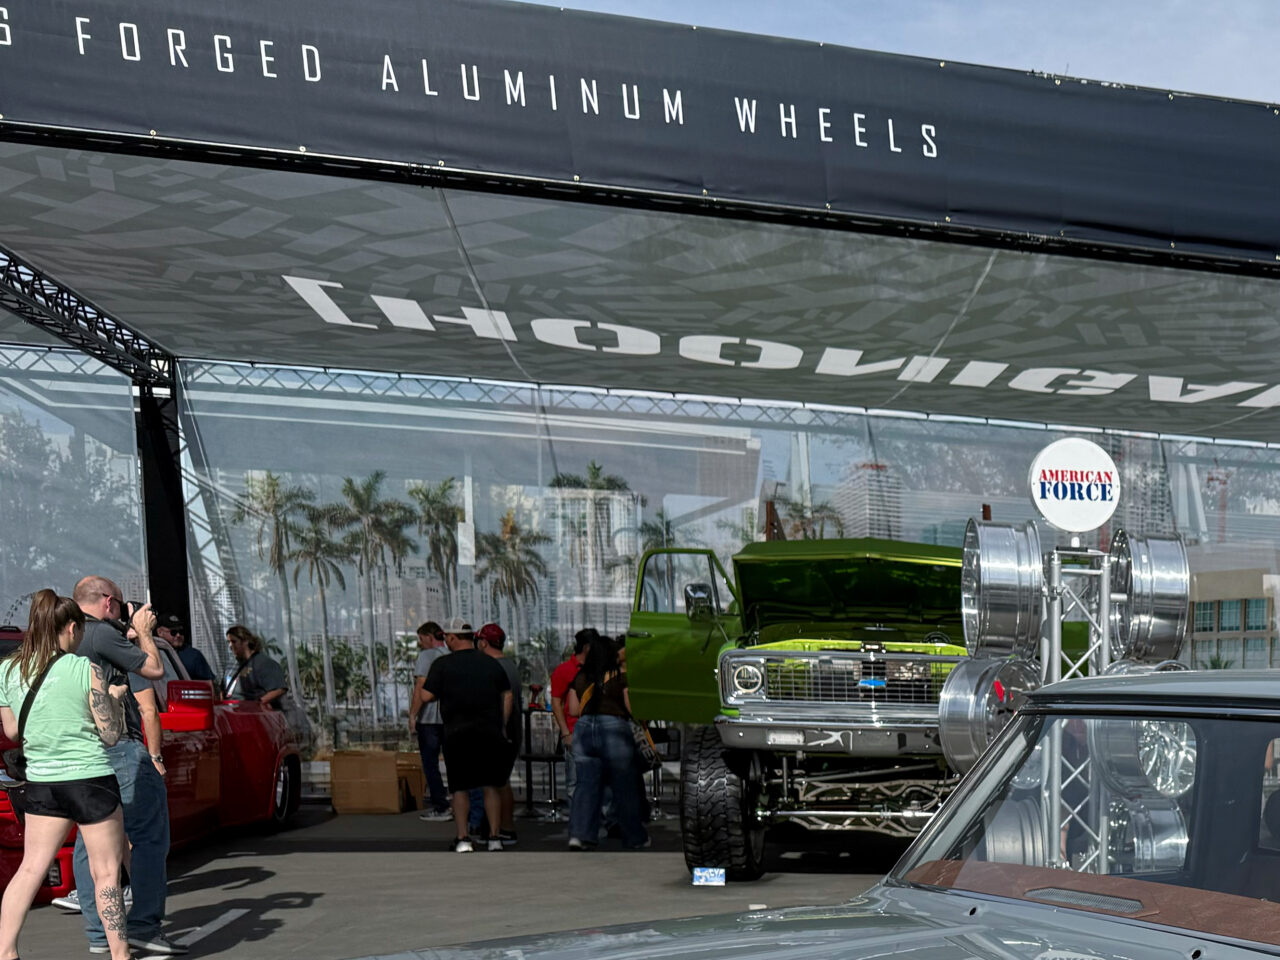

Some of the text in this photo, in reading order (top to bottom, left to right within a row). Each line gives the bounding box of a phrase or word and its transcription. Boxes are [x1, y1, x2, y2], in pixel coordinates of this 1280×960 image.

[75, 16, 322, 83] FORGED
[381, 54, 684, 126] ALUMINUM
[734, 97, 938, 158] WHEELS
[1039, 469, 1113, 483] AMERICAN
[1040, 481, 1113, 502] FORCE
